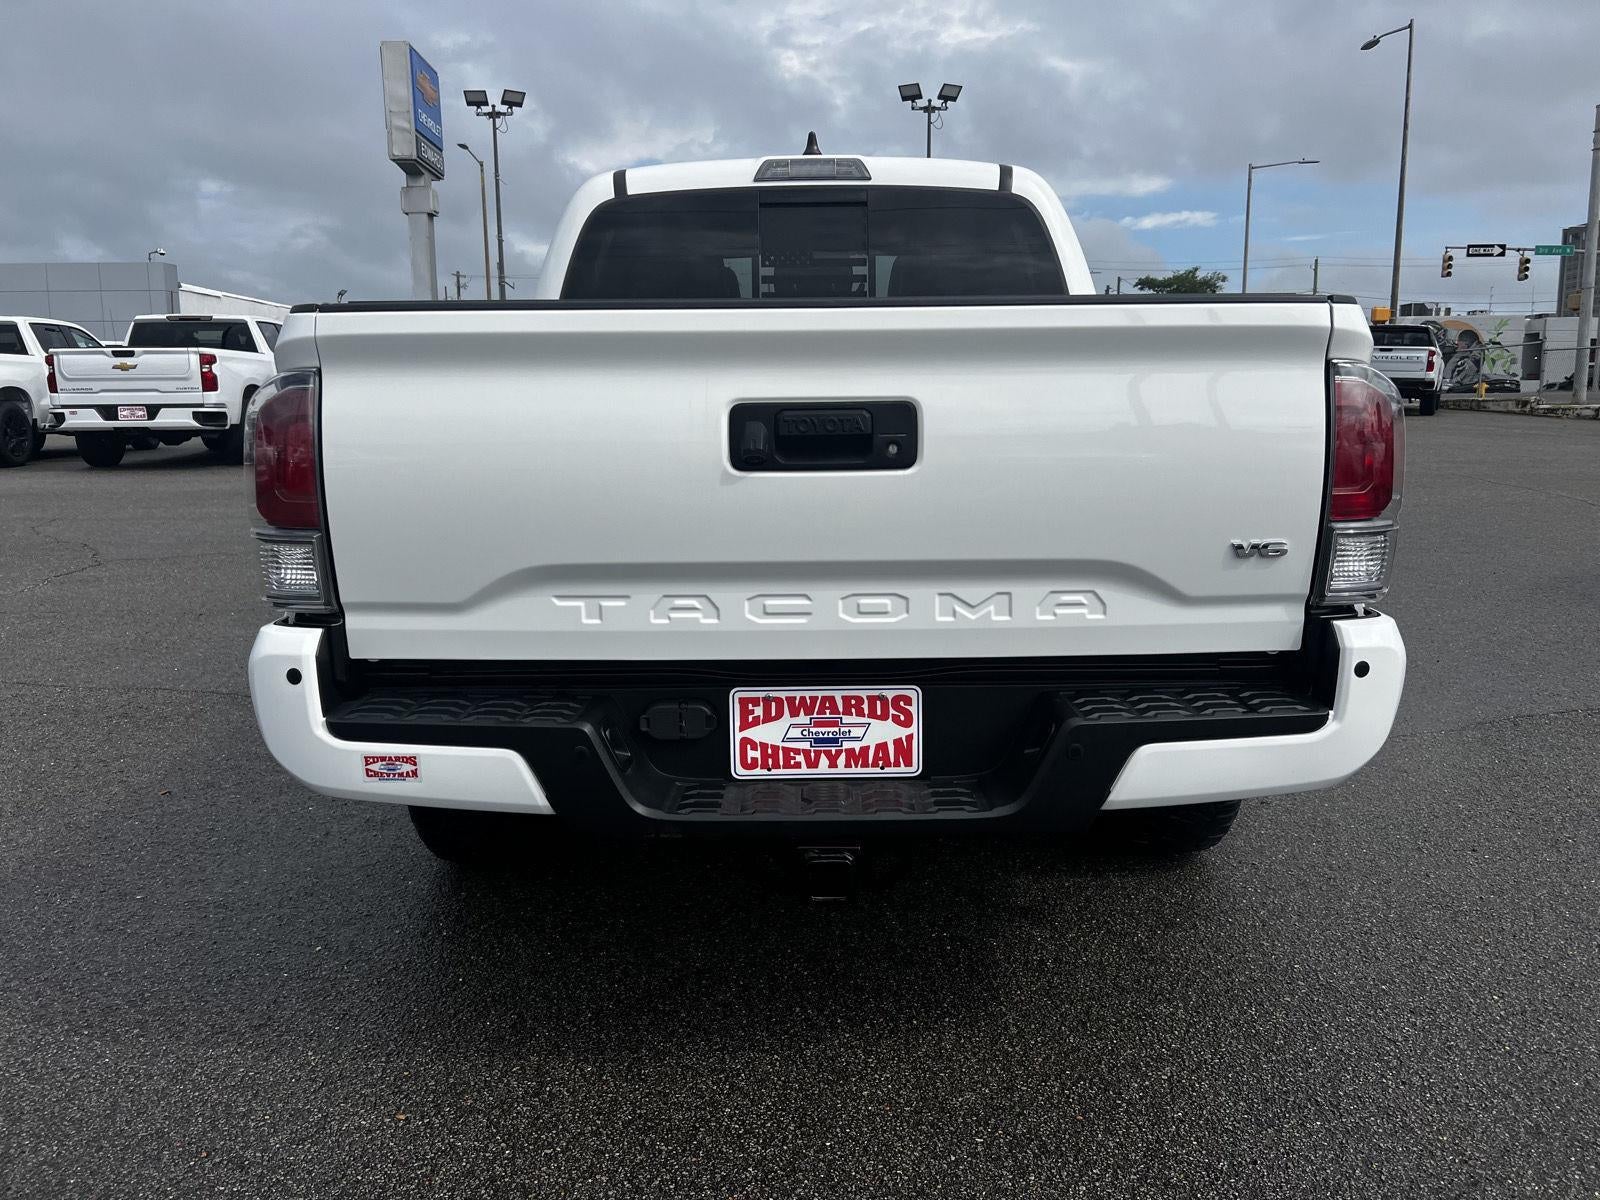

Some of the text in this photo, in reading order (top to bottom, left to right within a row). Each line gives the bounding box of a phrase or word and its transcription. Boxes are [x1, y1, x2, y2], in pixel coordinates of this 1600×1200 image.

[418, 109, 442, 138] CHEVROLET
[421, 142, 444, 170] EDWARDS
[782, 416, 867, 434] TOYOTA
[1230, 538, 1289, 559] V6
[551, 590, 1107, 624] TACOMA
[738, 694, 914, 733] EDWARDS
[800, 728, 852, 738] Chevrolet
[364, 755, 418, 767] EDWARDS
[739, 733, 914, 771] CHEVYMAN
[364, 767, 419, 778] CHEVYMAN
